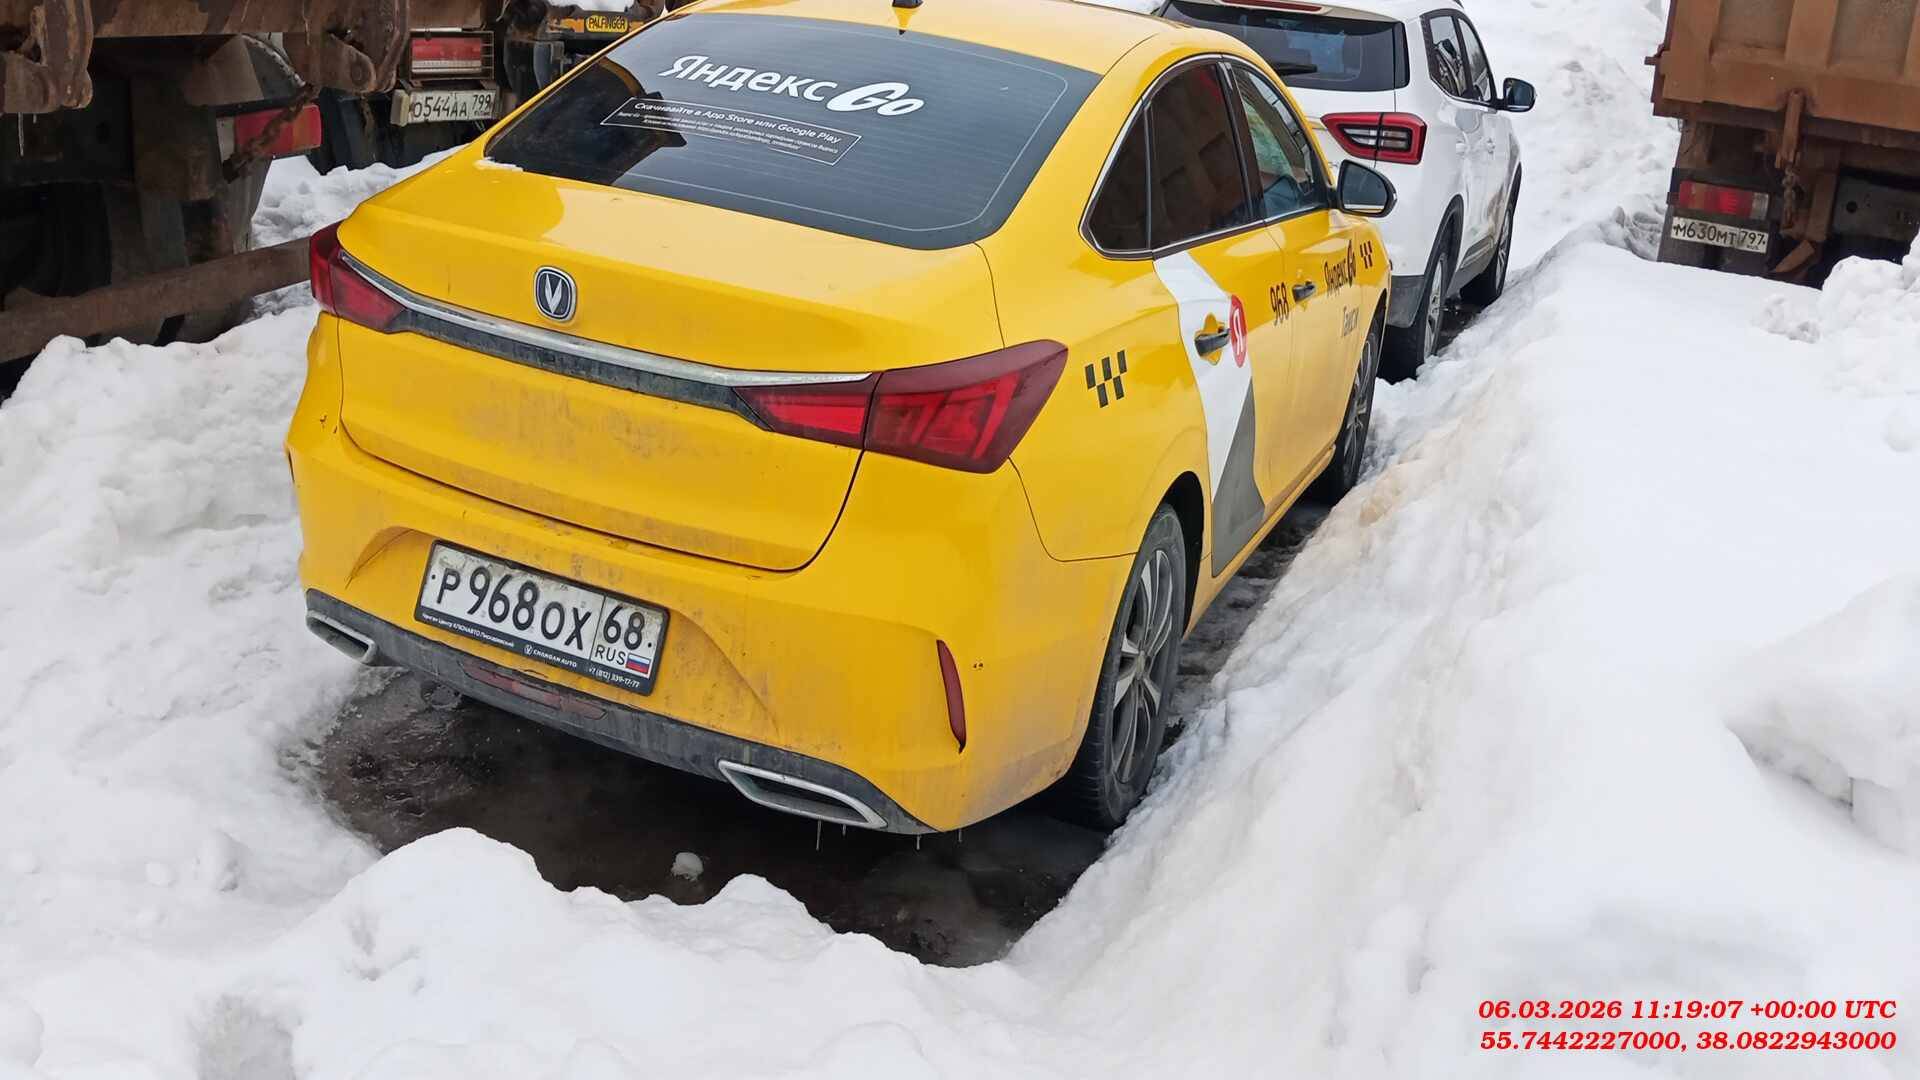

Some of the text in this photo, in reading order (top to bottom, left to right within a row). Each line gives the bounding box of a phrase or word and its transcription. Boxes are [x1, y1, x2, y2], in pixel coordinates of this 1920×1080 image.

[588, 16, 625, 30] PALFINGER
[658, 55, 925, 116] Яндекс Go
[413, 94, 491, 118] О544АА 799
[634, 102, 694, 115] Скачивайте
[701, 111, 725, 120] App
[726, 114, 754, 125] Store
[755, 120, 777, 129] или
[778, 124, 817, 137] Google
[817, 132, 842, 144] Play
[1675, 222, 1765, 246] М630МТ 797
[1270, 281, 1290, 326] 968
[1233, 307, 1244, 355] Я
[436, 566, 645, 650] Р968ОХ 68
[561, 658, 577, 668] AUTO
[594, 645, 627, 666] RUS
